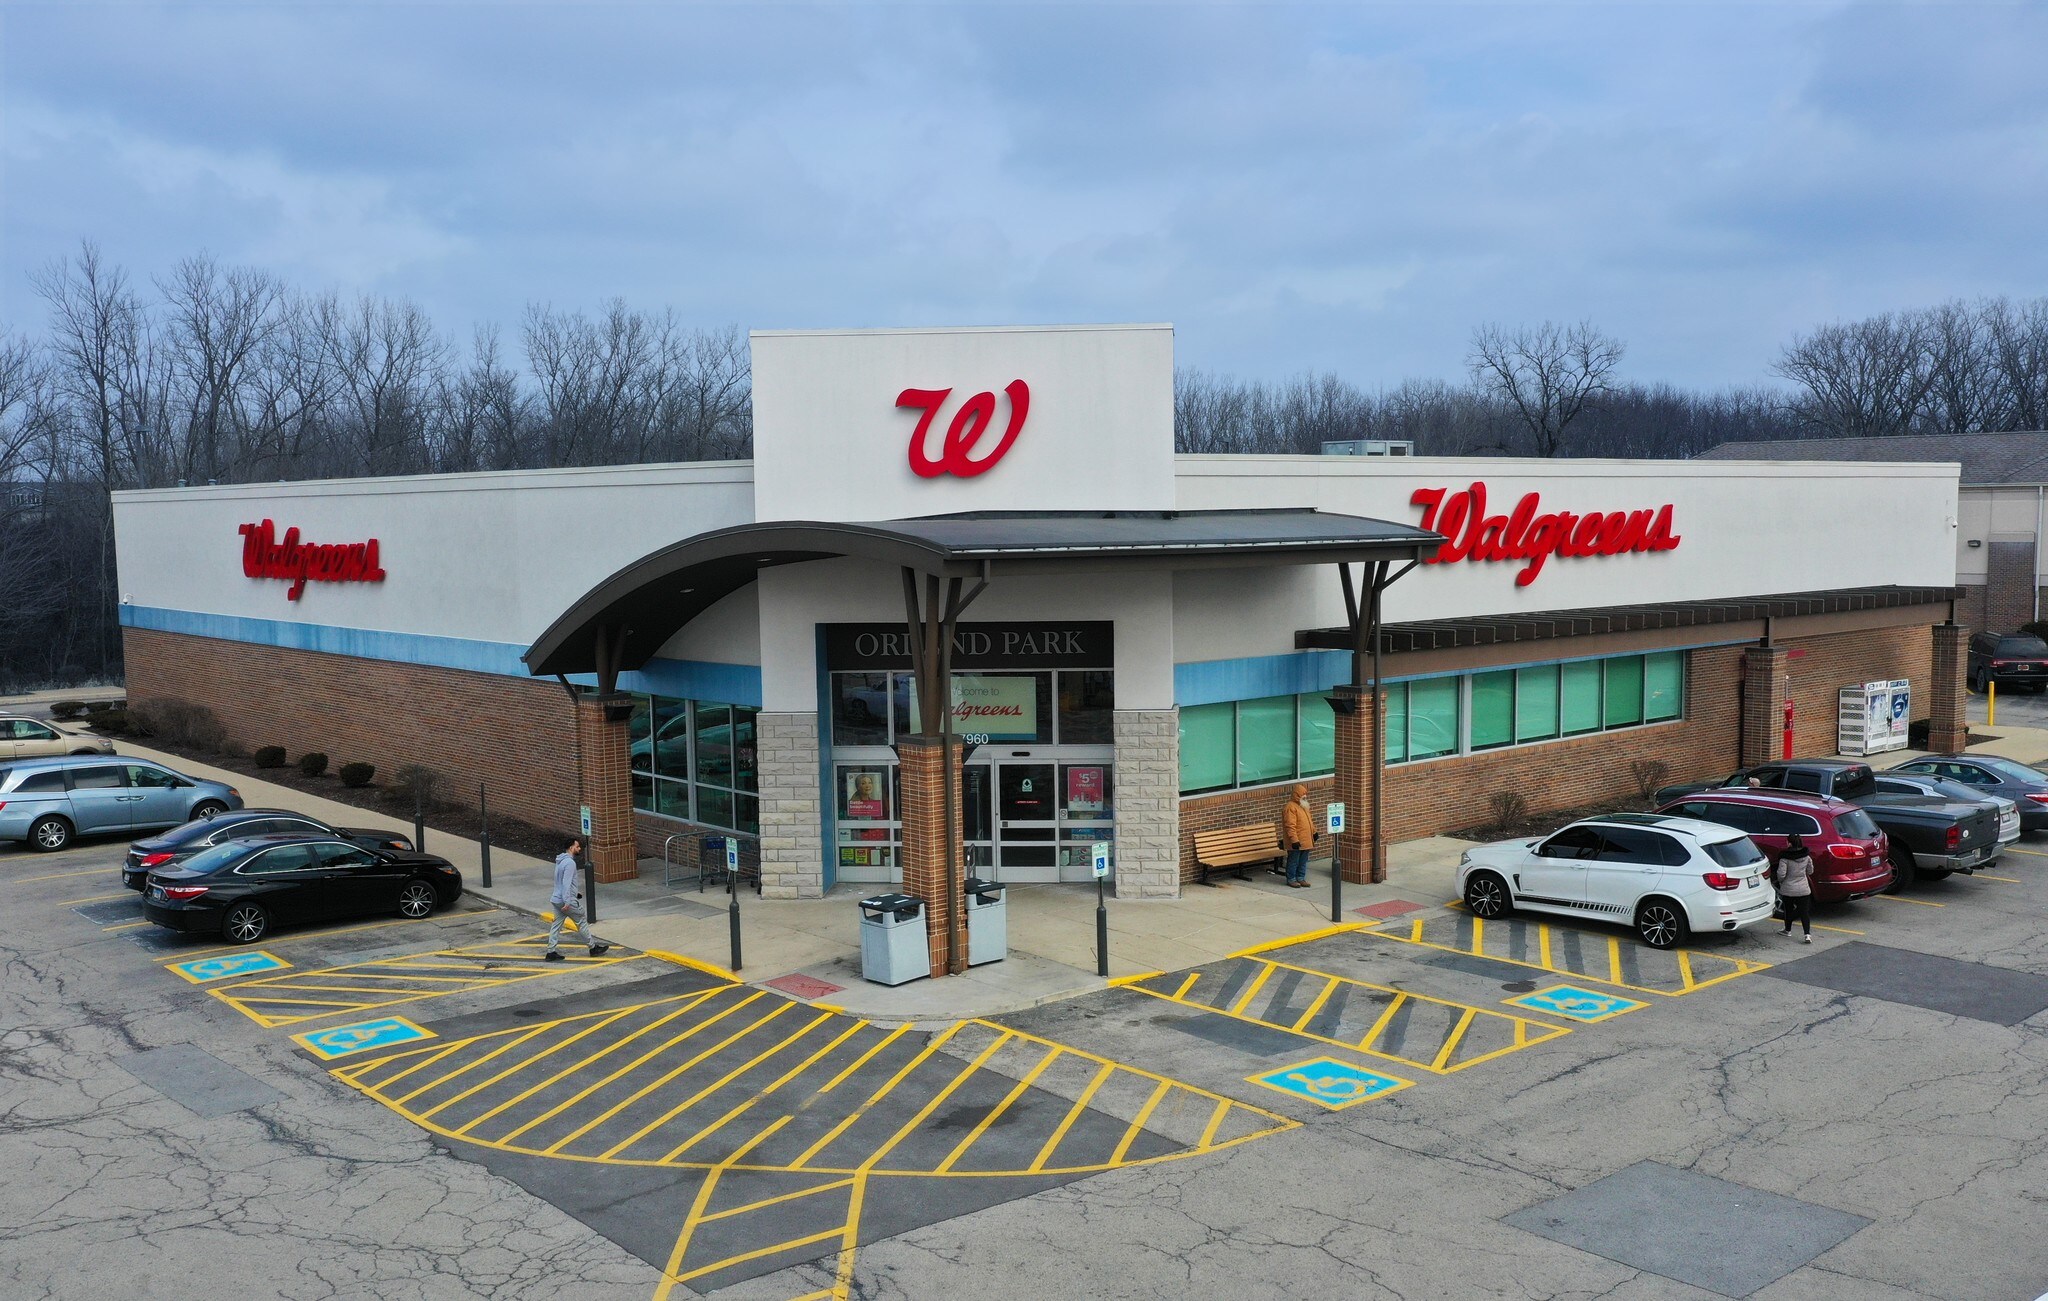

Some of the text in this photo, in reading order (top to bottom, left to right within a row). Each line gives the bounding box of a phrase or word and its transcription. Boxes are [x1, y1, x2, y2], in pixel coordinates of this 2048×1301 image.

[1410, 481, 1681, 587] Walgreens
[238, 518, 385, 601] Walgreens
[855, 631, 1086, 657] ORLND PARK
[990, 687, 1000, 696] to
[951, 701, 1023, 721] lgreens
[1079, 773, 1090, 783] $5
